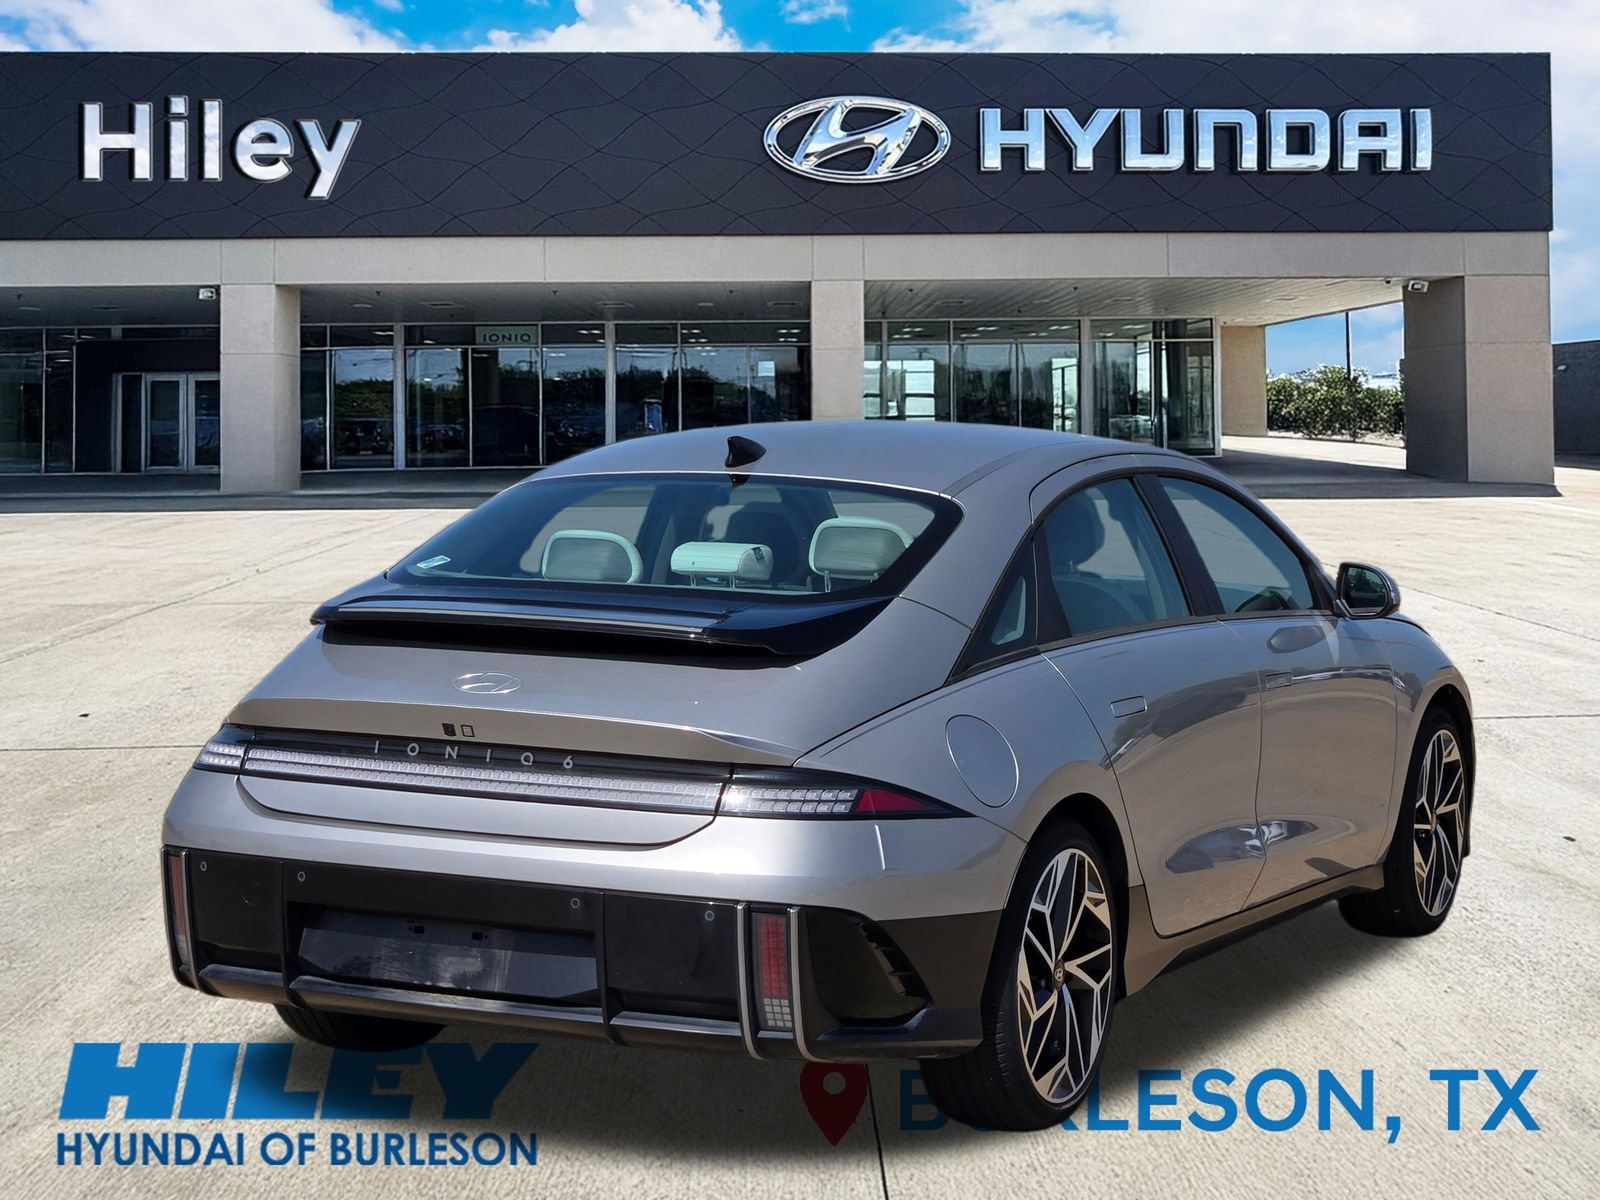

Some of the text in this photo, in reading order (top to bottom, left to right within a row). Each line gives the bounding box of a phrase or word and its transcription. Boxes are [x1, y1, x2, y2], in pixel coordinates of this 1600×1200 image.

[80, 95, 361, 199] Hiley
[979, 107, 1433, 173] HYUNDAI
[483, 333, 532, 343] IONIQ
